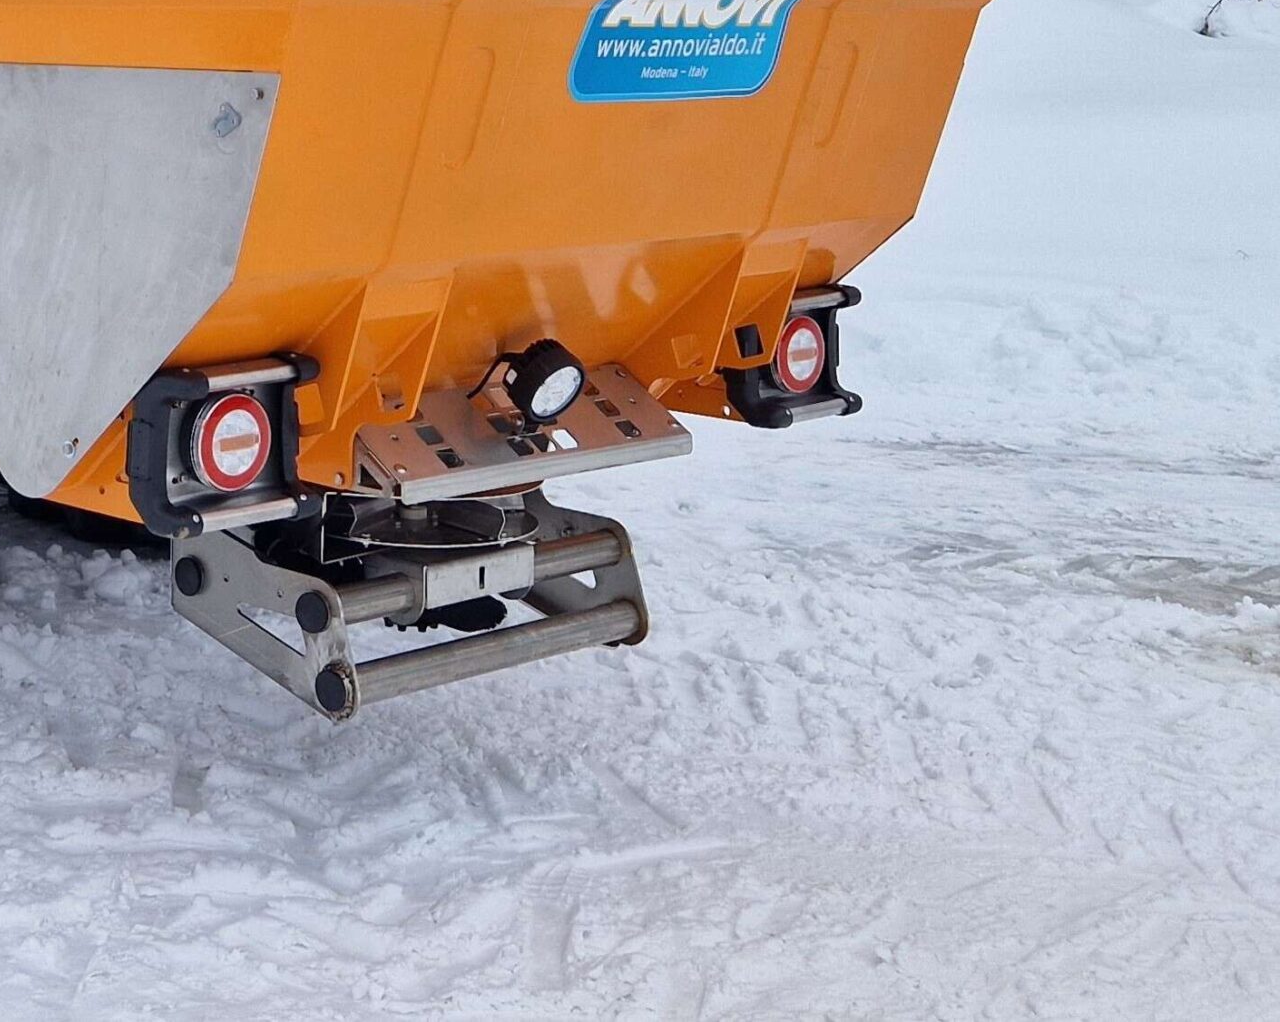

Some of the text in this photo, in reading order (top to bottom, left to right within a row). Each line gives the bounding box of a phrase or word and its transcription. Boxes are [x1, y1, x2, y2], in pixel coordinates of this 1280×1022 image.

[597, 33, 766, 58] www.annovialdo.it
[640, 65, 679, 79] Modena
[687, 65, 709, 79] Italy
